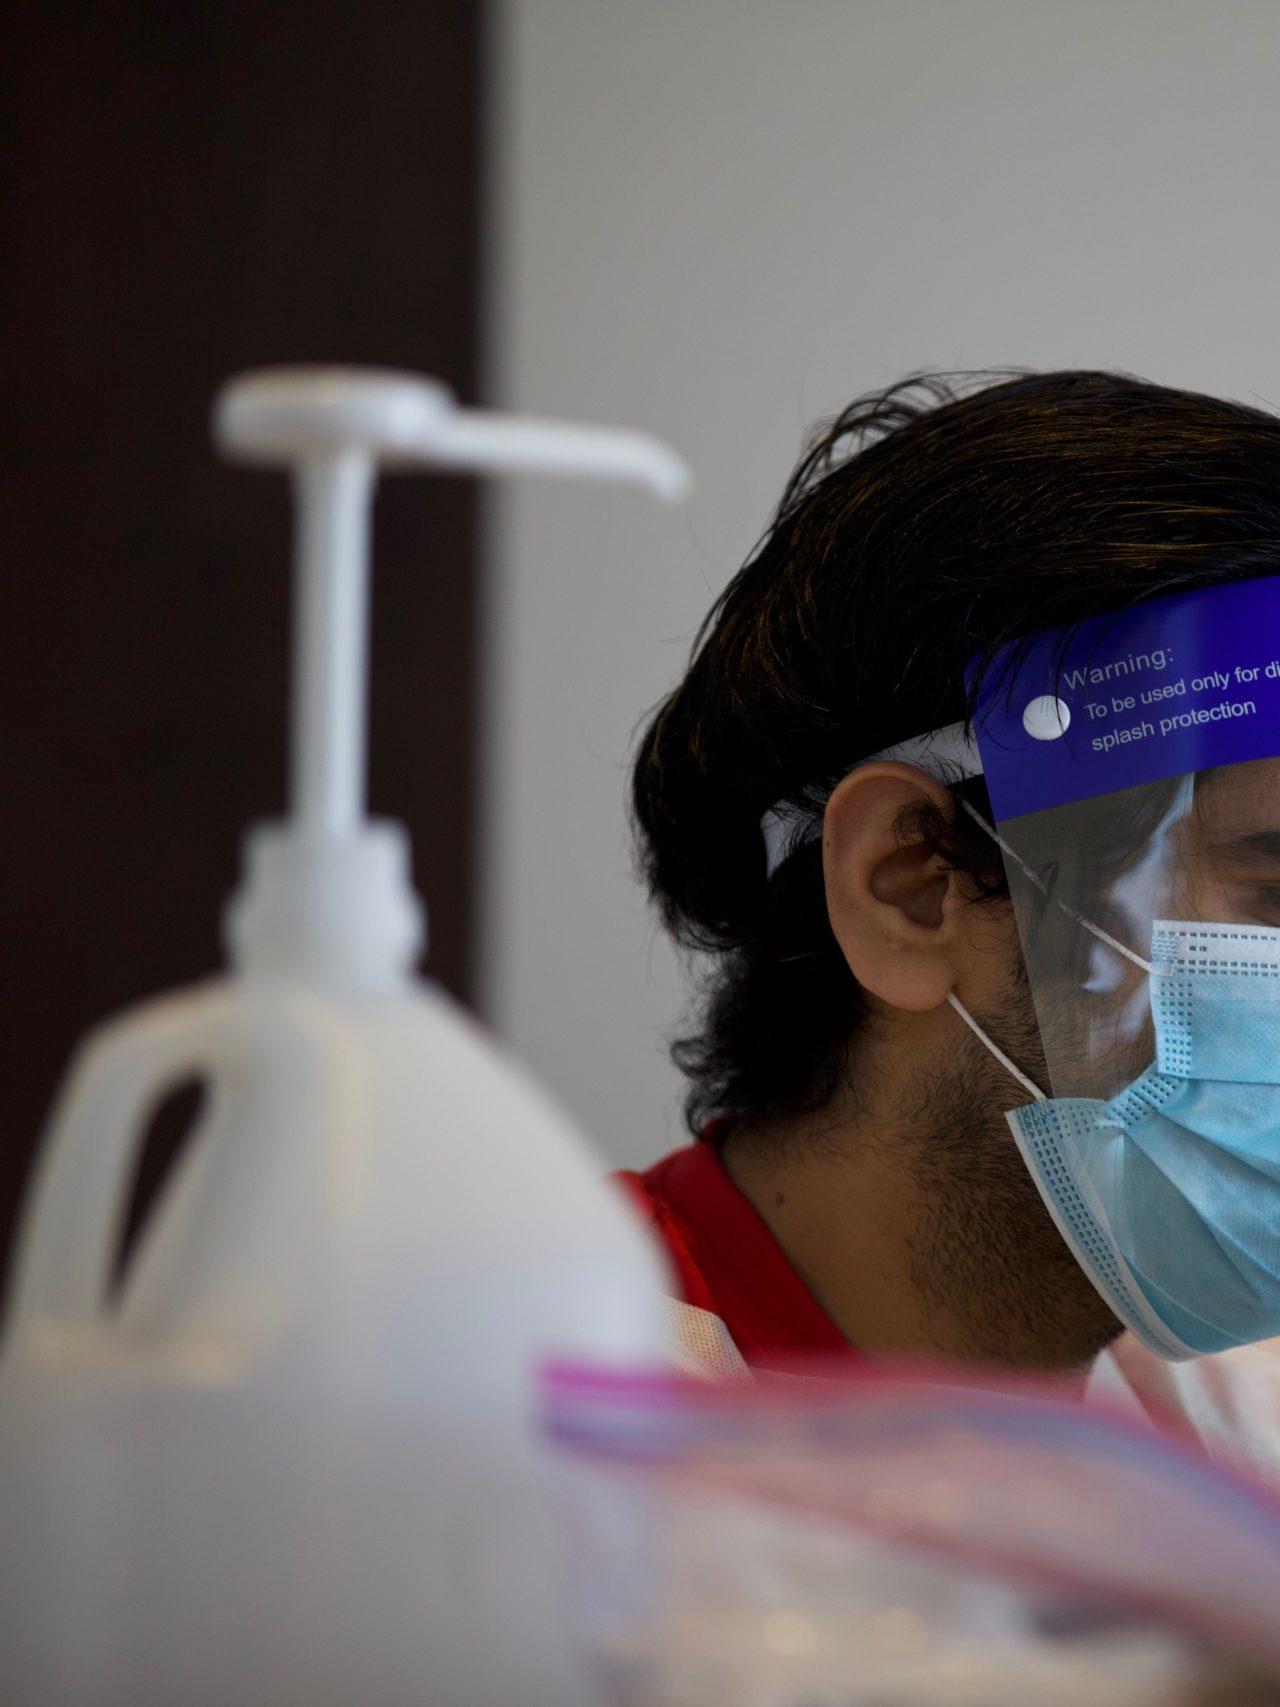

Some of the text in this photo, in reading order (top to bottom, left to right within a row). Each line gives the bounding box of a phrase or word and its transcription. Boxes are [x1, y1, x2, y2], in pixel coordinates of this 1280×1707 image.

[1063, 648, 1174, 690] Warning:
[1083, 702, 1108, 720] To
[1111, 697, 1136, 713] be
[1141, 678, 1187, 704] used
[1191, 670, 1230, 690] only
[1235, 666, 1260, 683] for
[1092, 700, 1257, 752] splash protection
